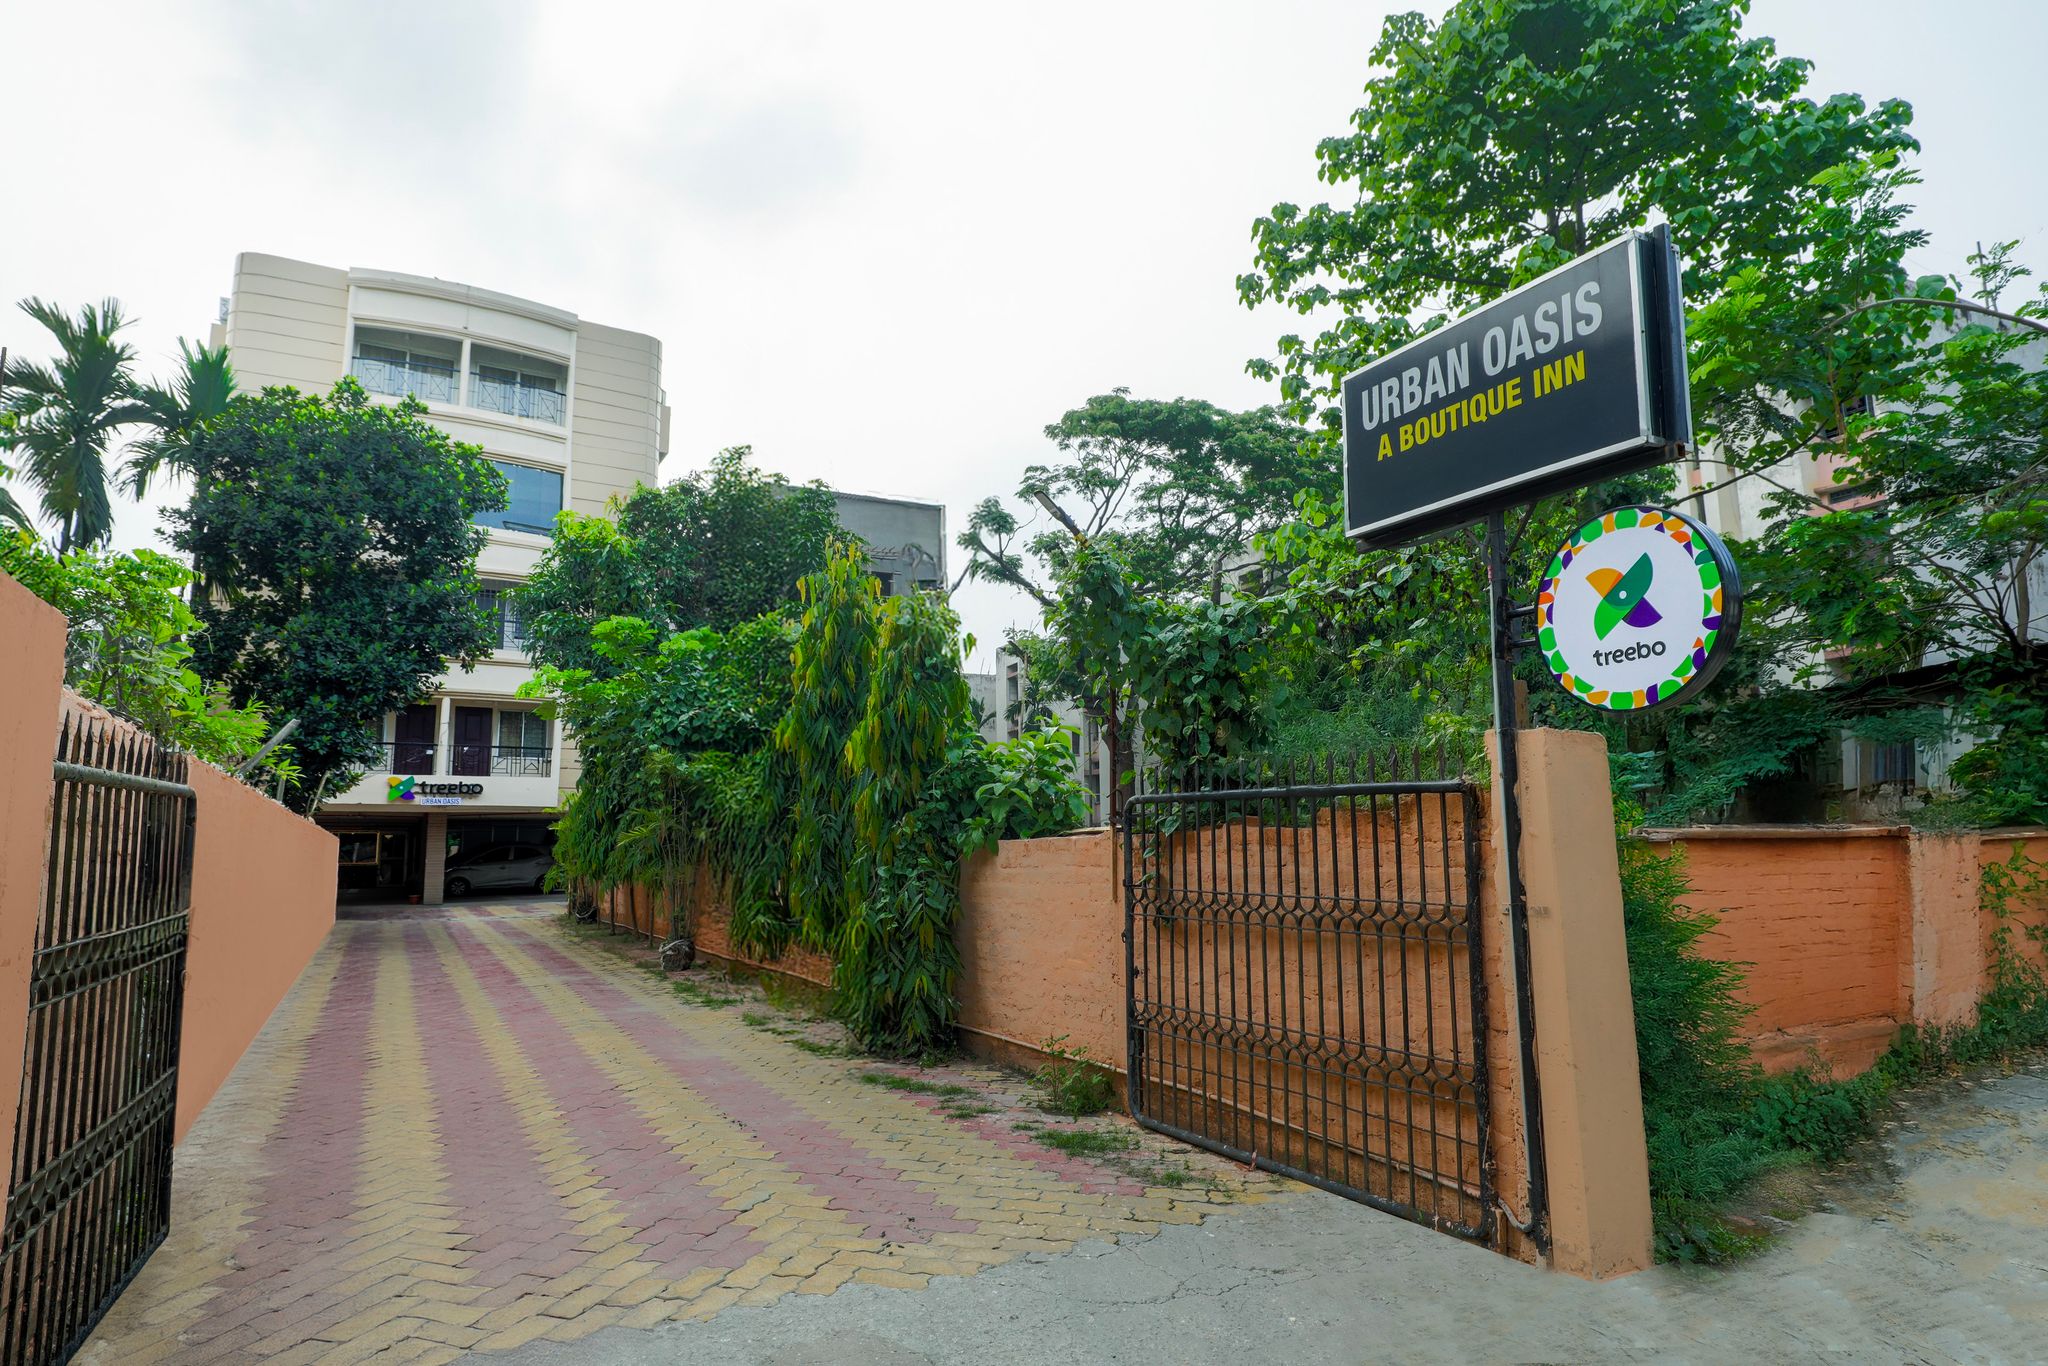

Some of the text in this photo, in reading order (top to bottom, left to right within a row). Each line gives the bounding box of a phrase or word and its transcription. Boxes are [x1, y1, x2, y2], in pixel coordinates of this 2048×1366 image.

[1361, 280, 1603, 431] URBAN OASIS
[1377, 350, 1586, 462] A BOUTIQUE INN
[1592, 640, 1667, 667] treebo
[419, 780, 484, 795] treebo
